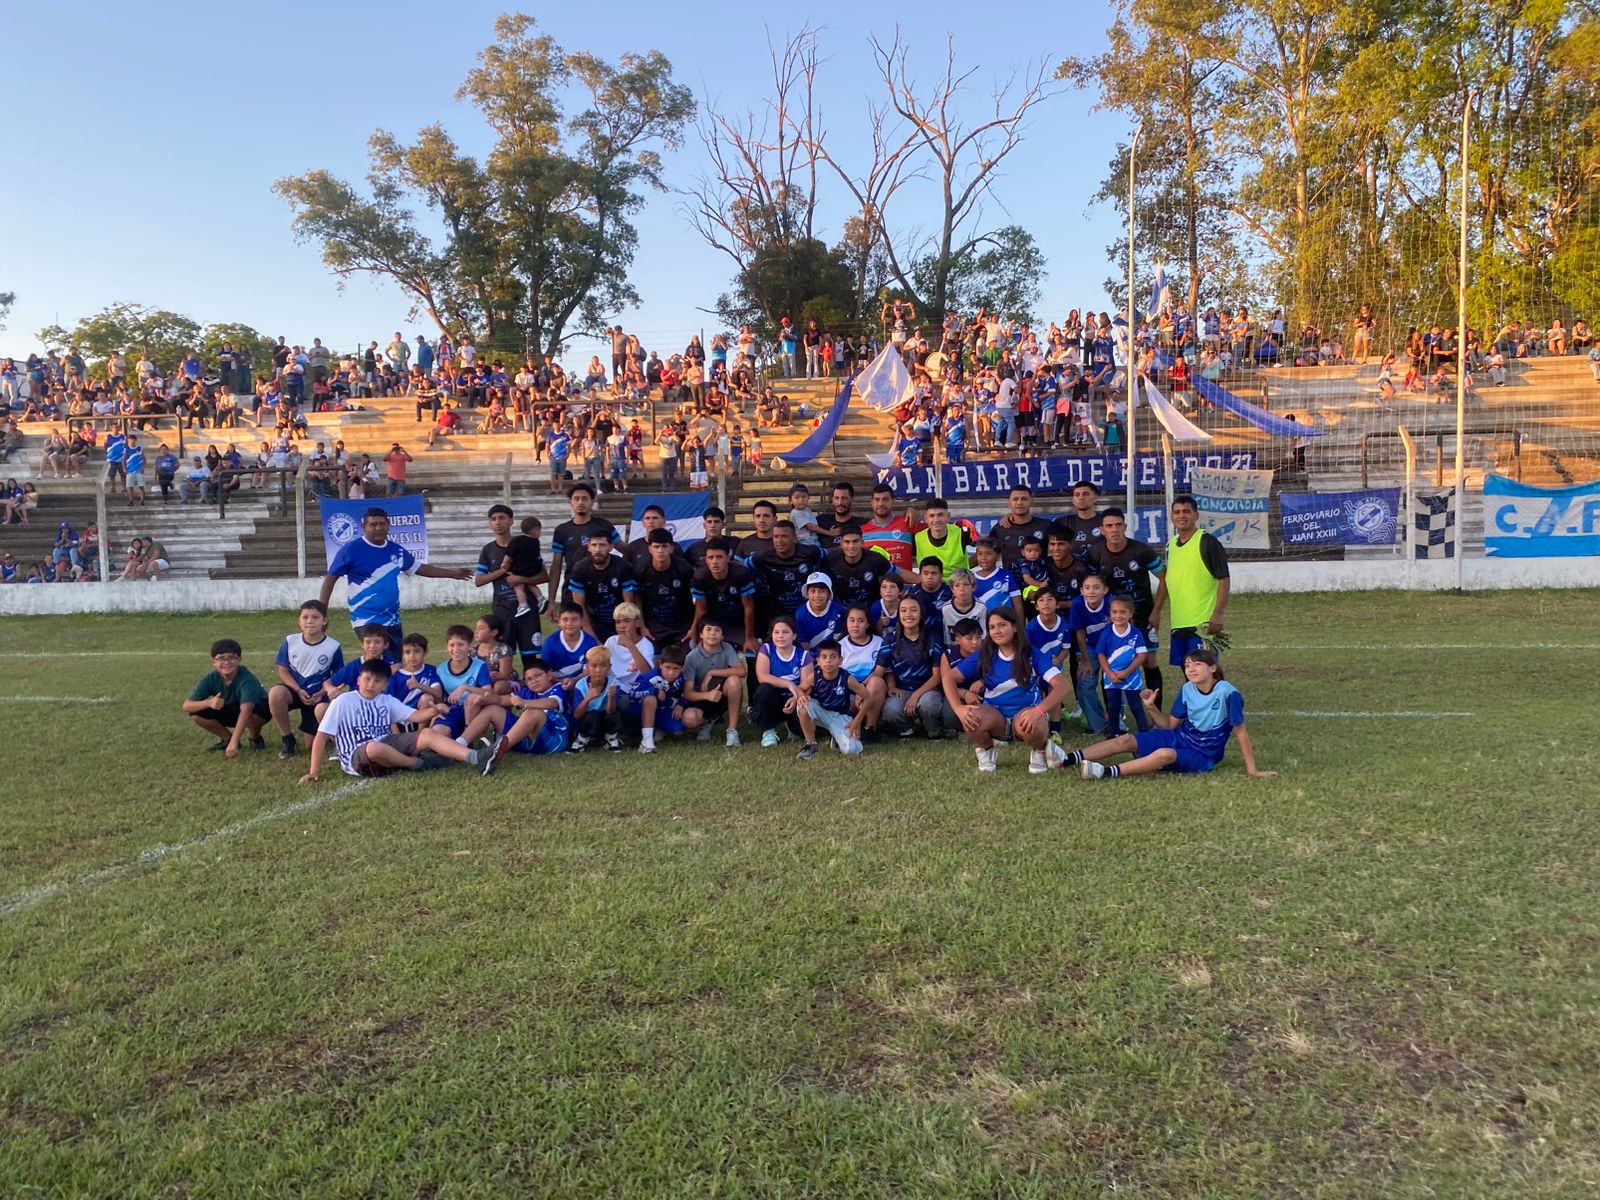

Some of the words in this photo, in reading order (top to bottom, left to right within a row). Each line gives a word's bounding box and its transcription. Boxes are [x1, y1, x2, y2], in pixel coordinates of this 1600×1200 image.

[952, 460, 1052, 493] BARRA
[1066, 458, 1104, 487] DE
[1119, 456, 1221, 486] FER
[387, 514, 421, 527] UERZO
[1282, 508, 1340, 525] FERROVIARIO
[1303, 521, 1321, 531] DEL
[1290, 531, 1314, 542] JUAN
[1316, 528, 1337, 539] XXIII
